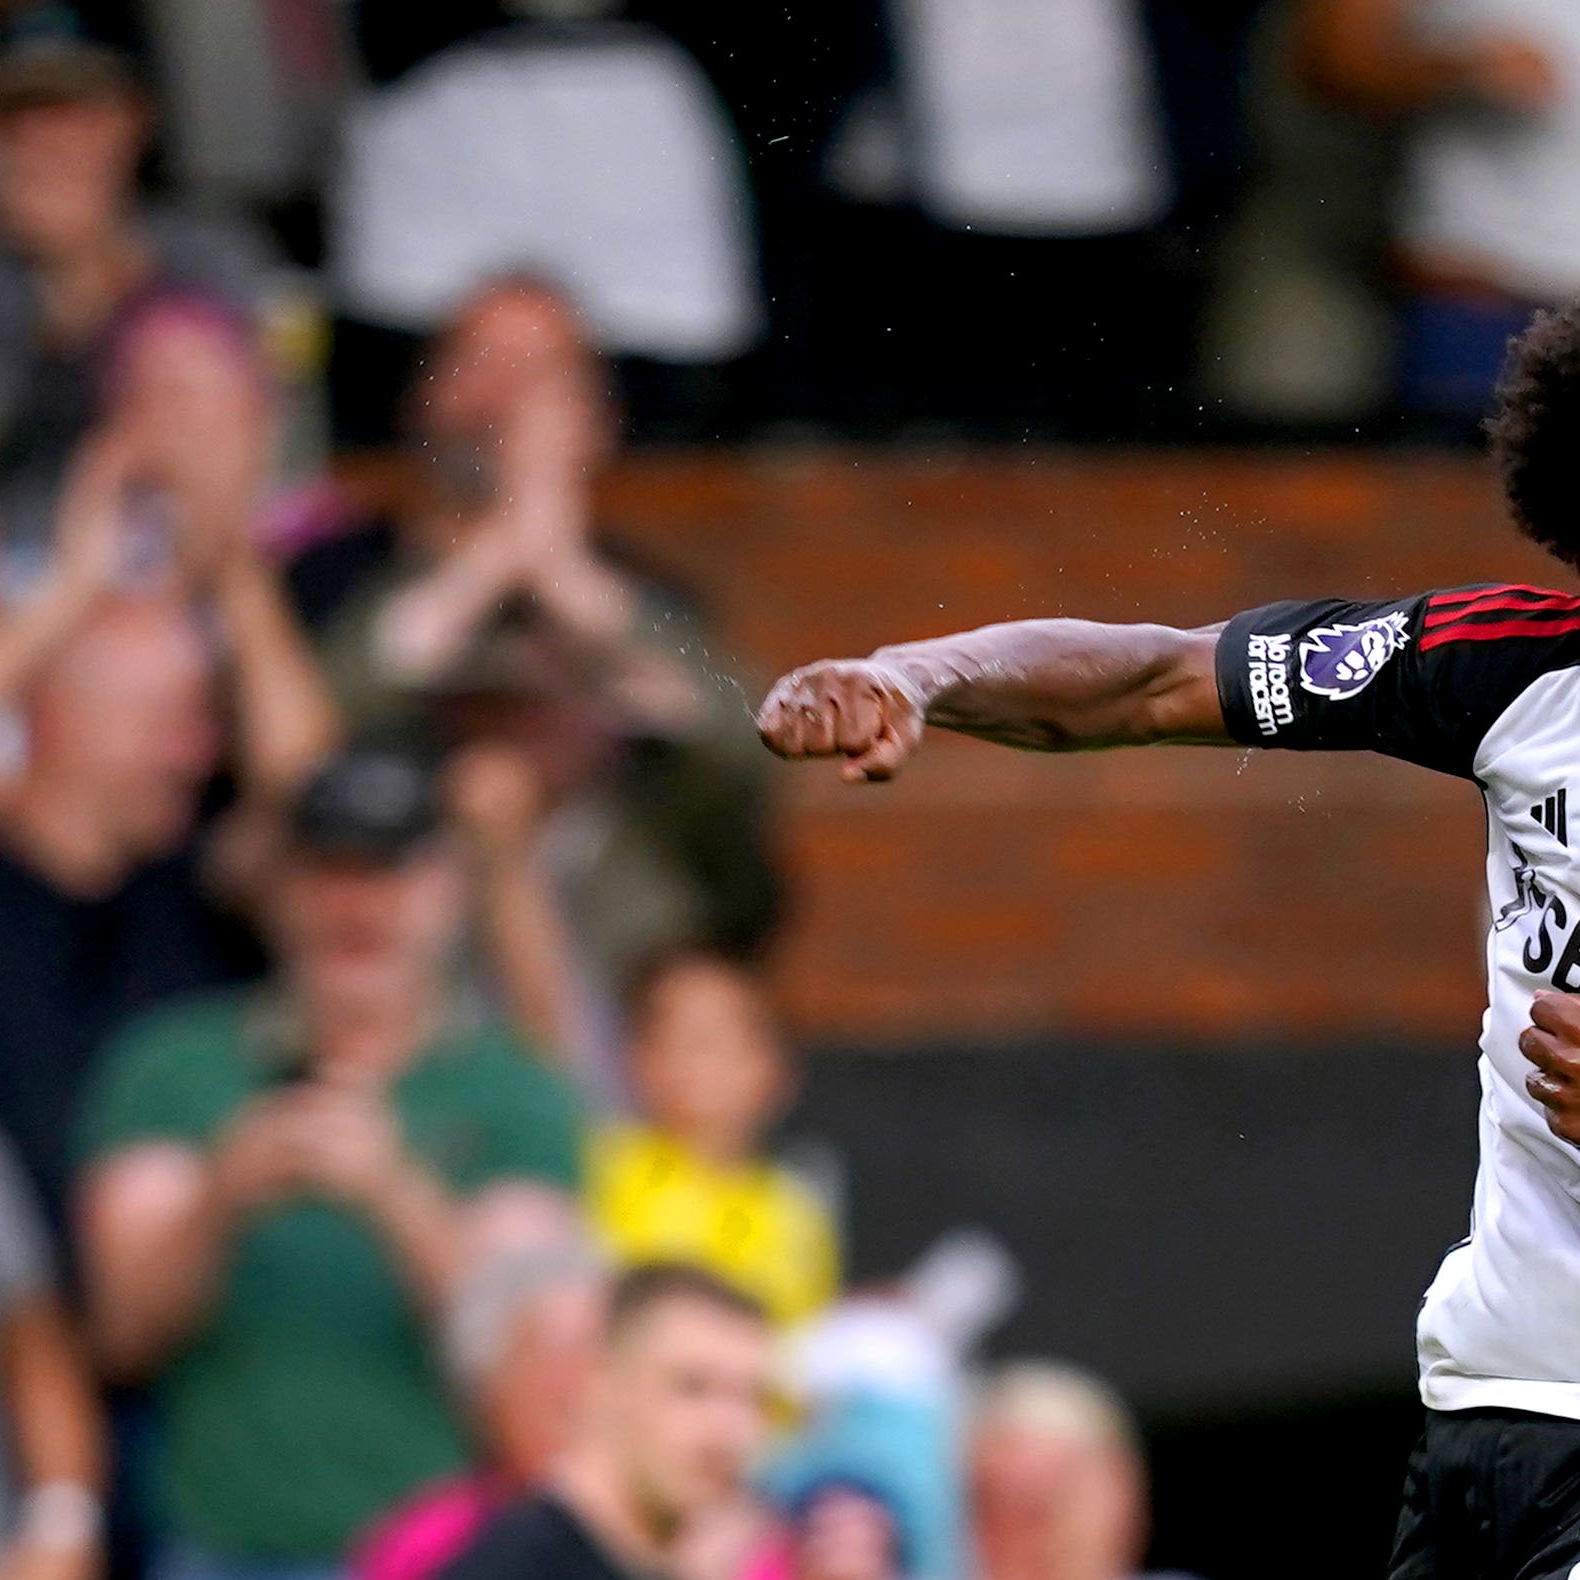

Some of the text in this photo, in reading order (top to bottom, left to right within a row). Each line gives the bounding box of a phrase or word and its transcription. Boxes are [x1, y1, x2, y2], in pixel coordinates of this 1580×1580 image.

[1247, 633, 1279, 736] for racism
[1268, 633, 1295, 725] No room
